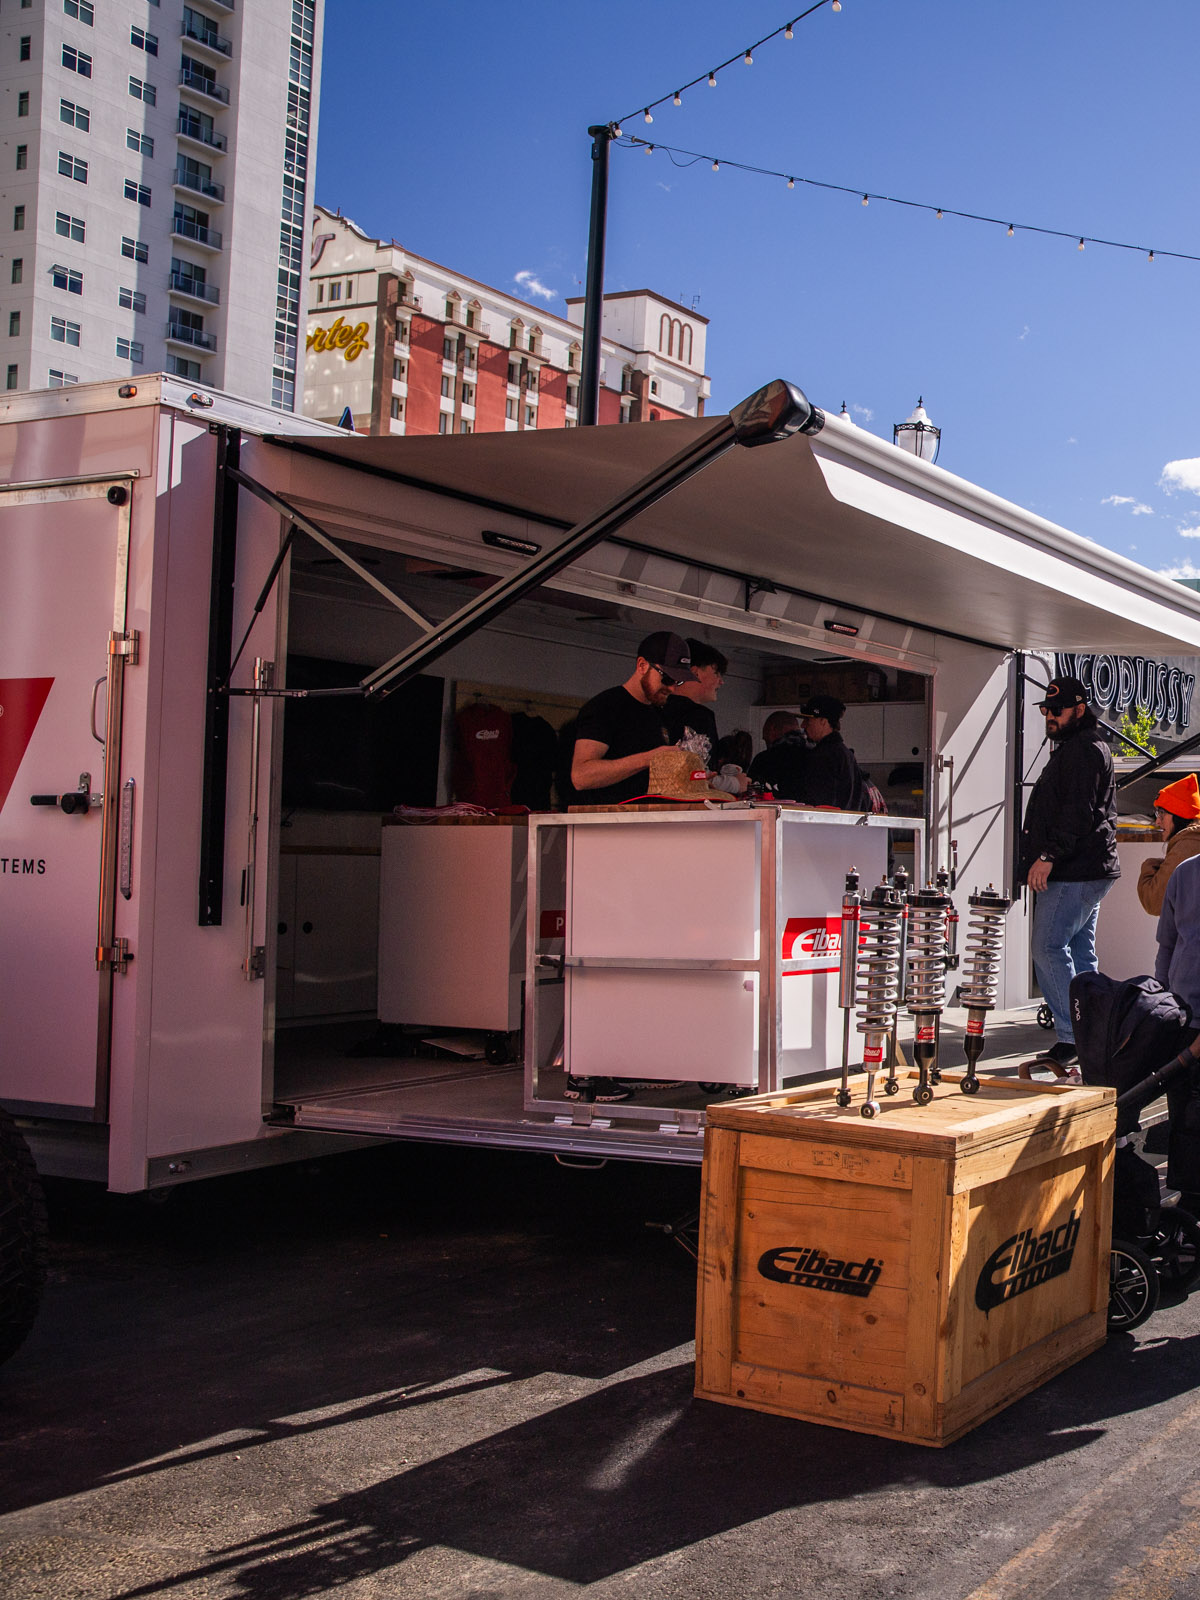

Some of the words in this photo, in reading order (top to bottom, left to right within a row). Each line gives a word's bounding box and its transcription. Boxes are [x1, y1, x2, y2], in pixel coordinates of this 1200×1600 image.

[0, 858, 46, 875] TEMS
[791, 928, 842, 959] Eiba
[757, 1246, 883, 1298] Eibach
[974, 1209, 1080, 1313] Eibach
